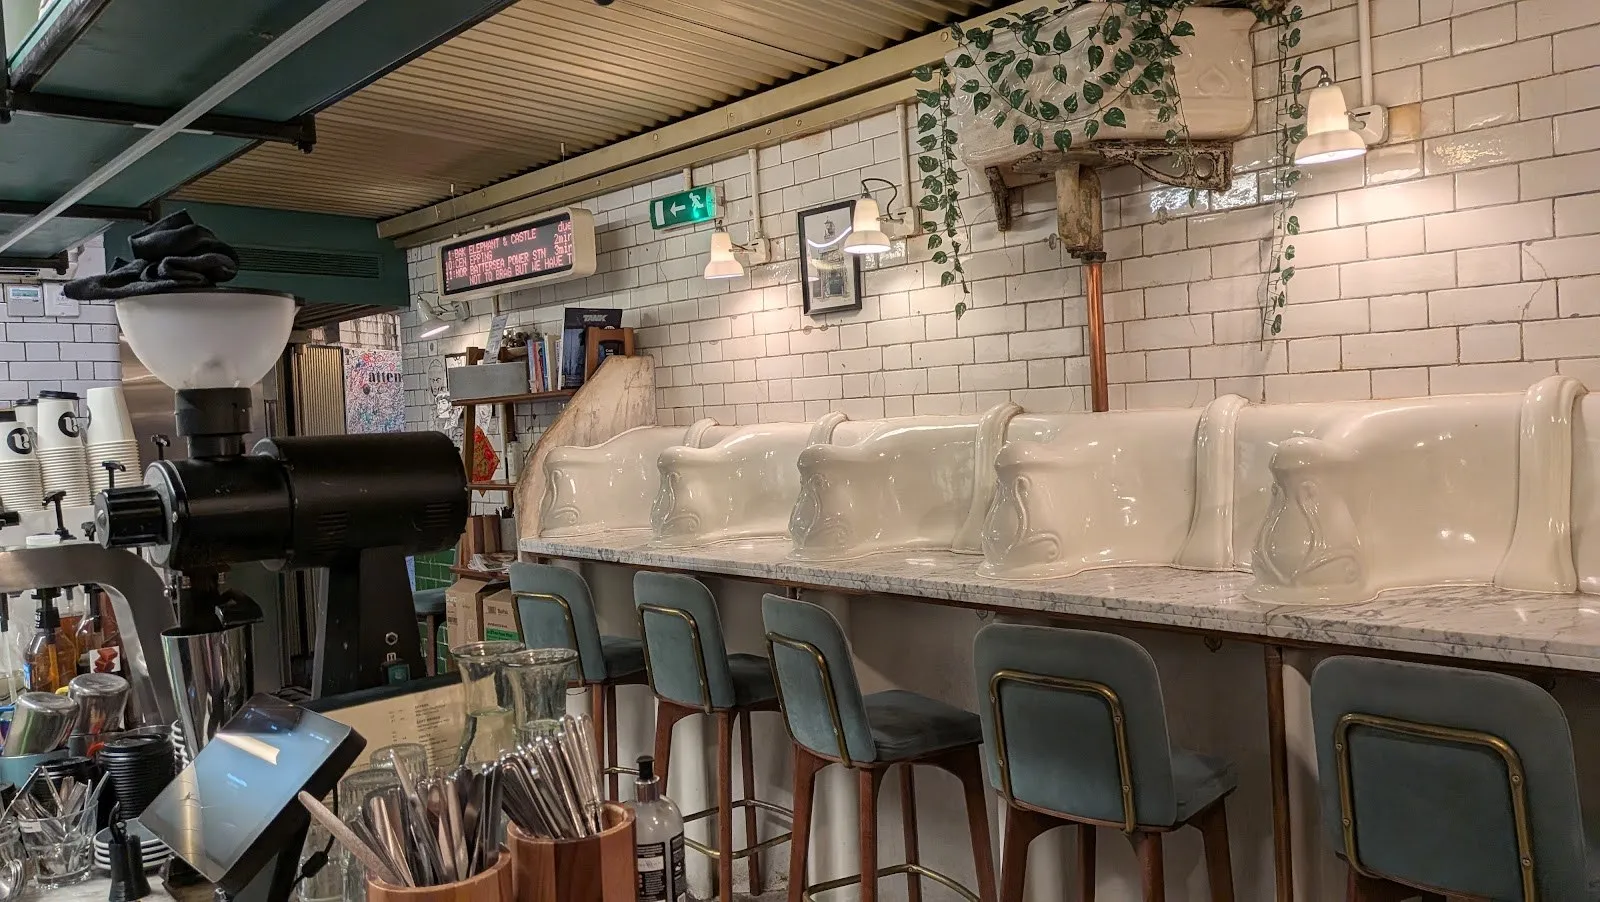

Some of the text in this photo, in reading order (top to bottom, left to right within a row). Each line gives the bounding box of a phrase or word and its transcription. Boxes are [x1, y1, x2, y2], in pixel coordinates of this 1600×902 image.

[469, 238, 500, 255] ELEPHANT
[511, 228, 536, 244] CASTLE
[557, 221, 572, 232] due
[469, 251, 493, 265] EPPING
[469, 258, 505, 275] BATTERSEA
[507, 252, 529, 267] POWER
[532, 247, 547, 260] STN
[470, 273, 482, 285] NOT
[484, 271, 493, 282] TO
[496, 267, 512, 280] BRAG
[515, 263, 528, 275] BUT
[531, 260, 541, 272] WE
[544, 255, 563, 269] HAVE
[582, 314, 608, 322] TANK
[368, 370, 402, 383] atten
